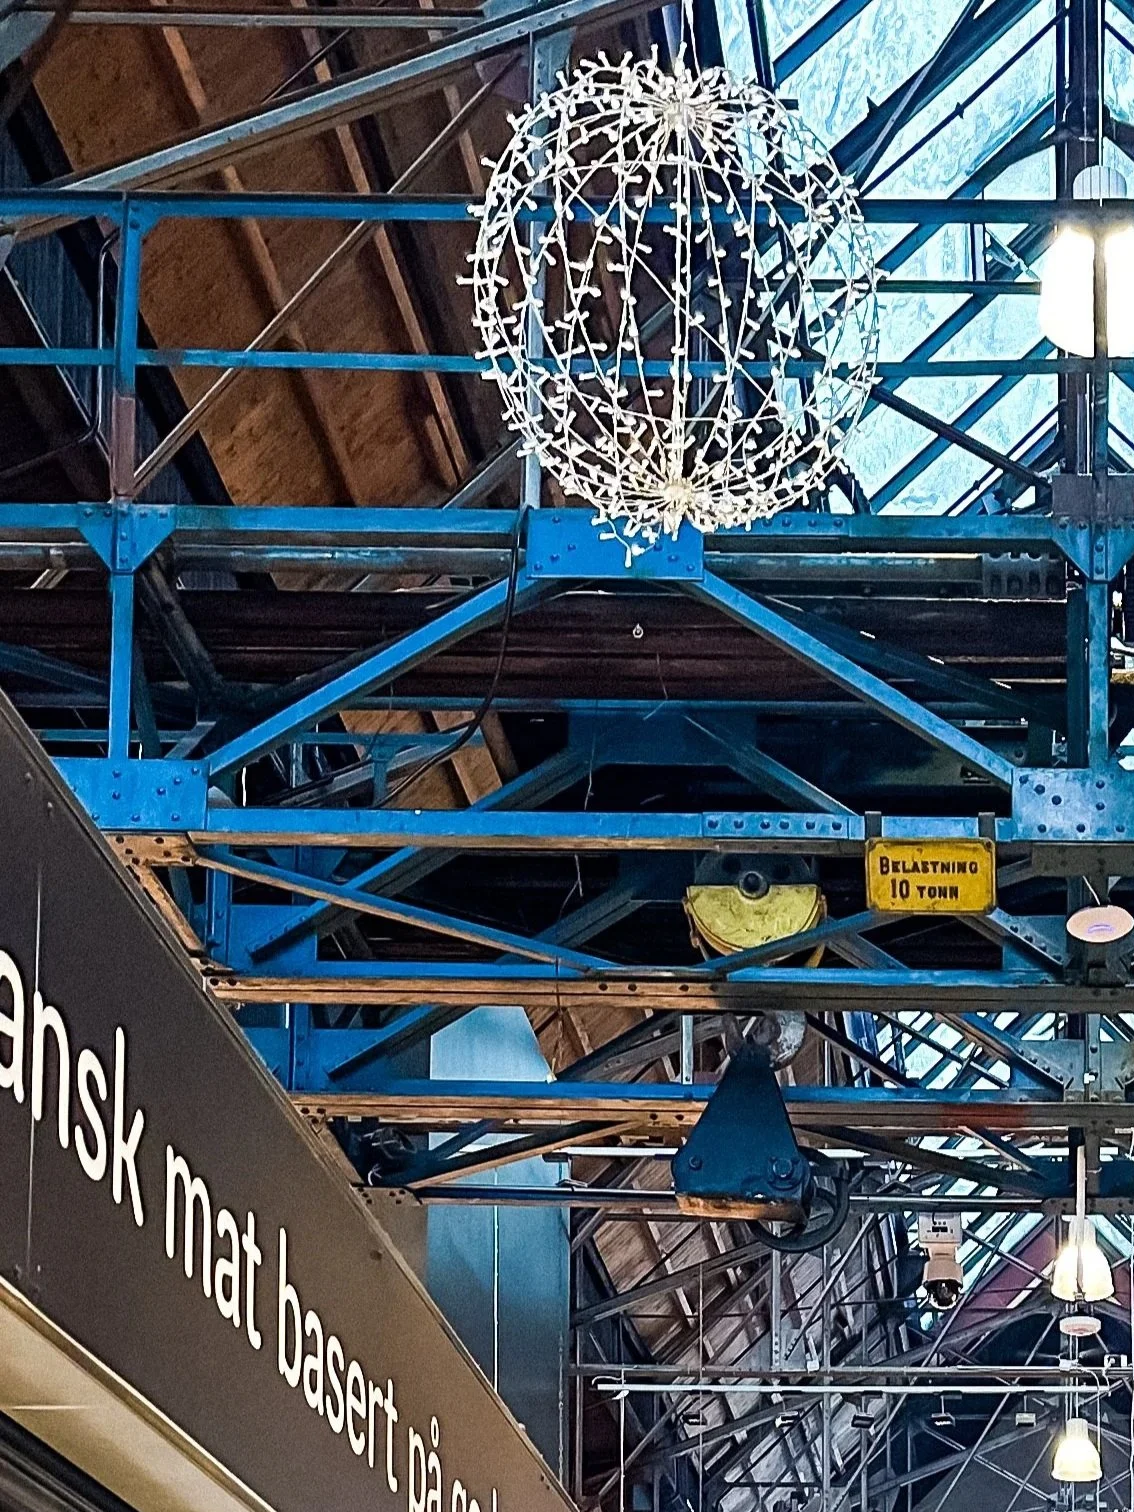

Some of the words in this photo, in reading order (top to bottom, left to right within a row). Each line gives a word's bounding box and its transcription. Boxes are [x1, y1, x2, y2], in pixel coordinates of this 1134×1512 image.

[879, 855, 979, 875] BELASTNING
[890, 878, 910, 900] 10
[916, 884, 960, 900] TONN
[165, 1144, 262, 1346] mat
[278, 1228, 400, 1492] basert
